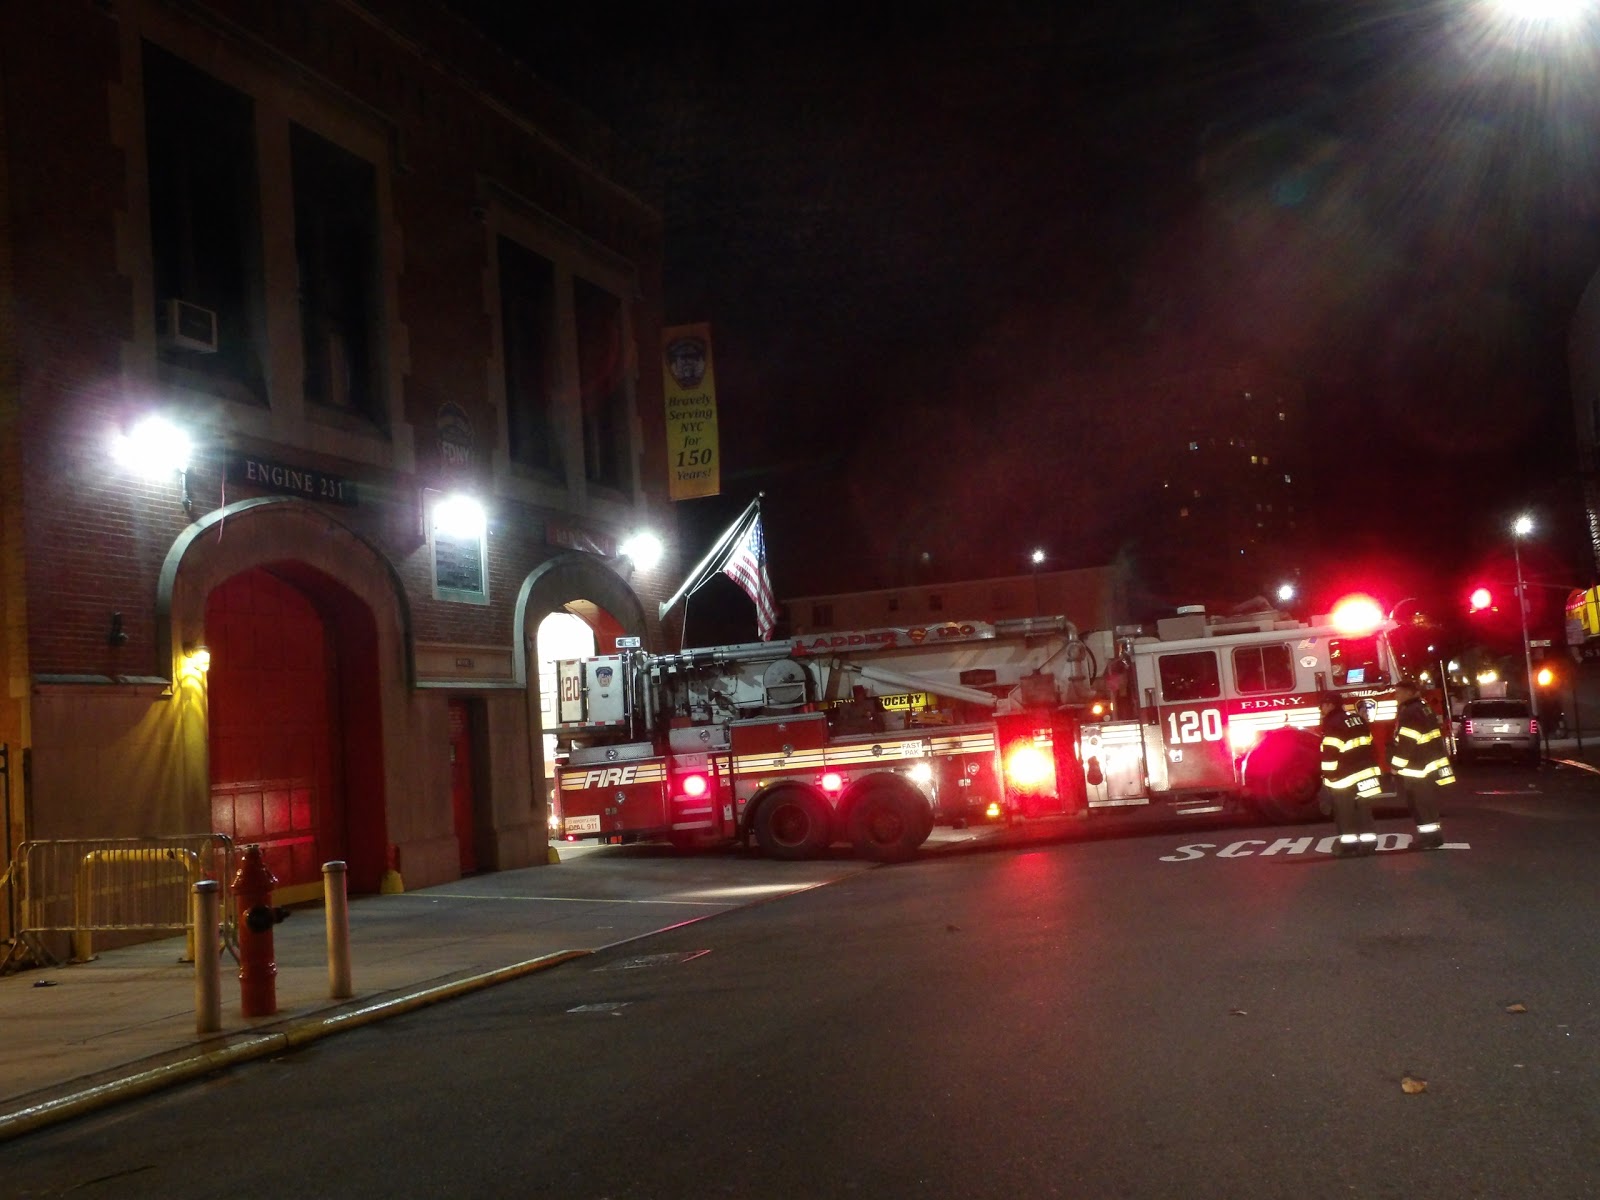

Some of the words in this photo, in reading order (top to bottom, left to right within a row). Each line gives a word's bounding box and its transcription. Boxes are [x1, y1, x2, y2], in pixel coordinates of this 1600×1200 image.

[668, 393, 712, 407] Bravely
[668, 409, 713, 421] Serving
[679, 421, 705, 433] NYC
[683, 434, 703, 449] for
[676, 447, 712, 468] 150
[245, 460, 314, 493] ENGINE
[320, 477, 344, 500] 231
[676, 467, 713, 481] Years!
[793, 631, 898, 656] LADDER
[561, 675, 580, 702] 120
[1240, 696, 1306, 710] F.D.N.Y.
[1167, 708, 1224, 745] 120
[901, 741, 921, 750] FAST
[583, 765, 638, 790] FIRE
